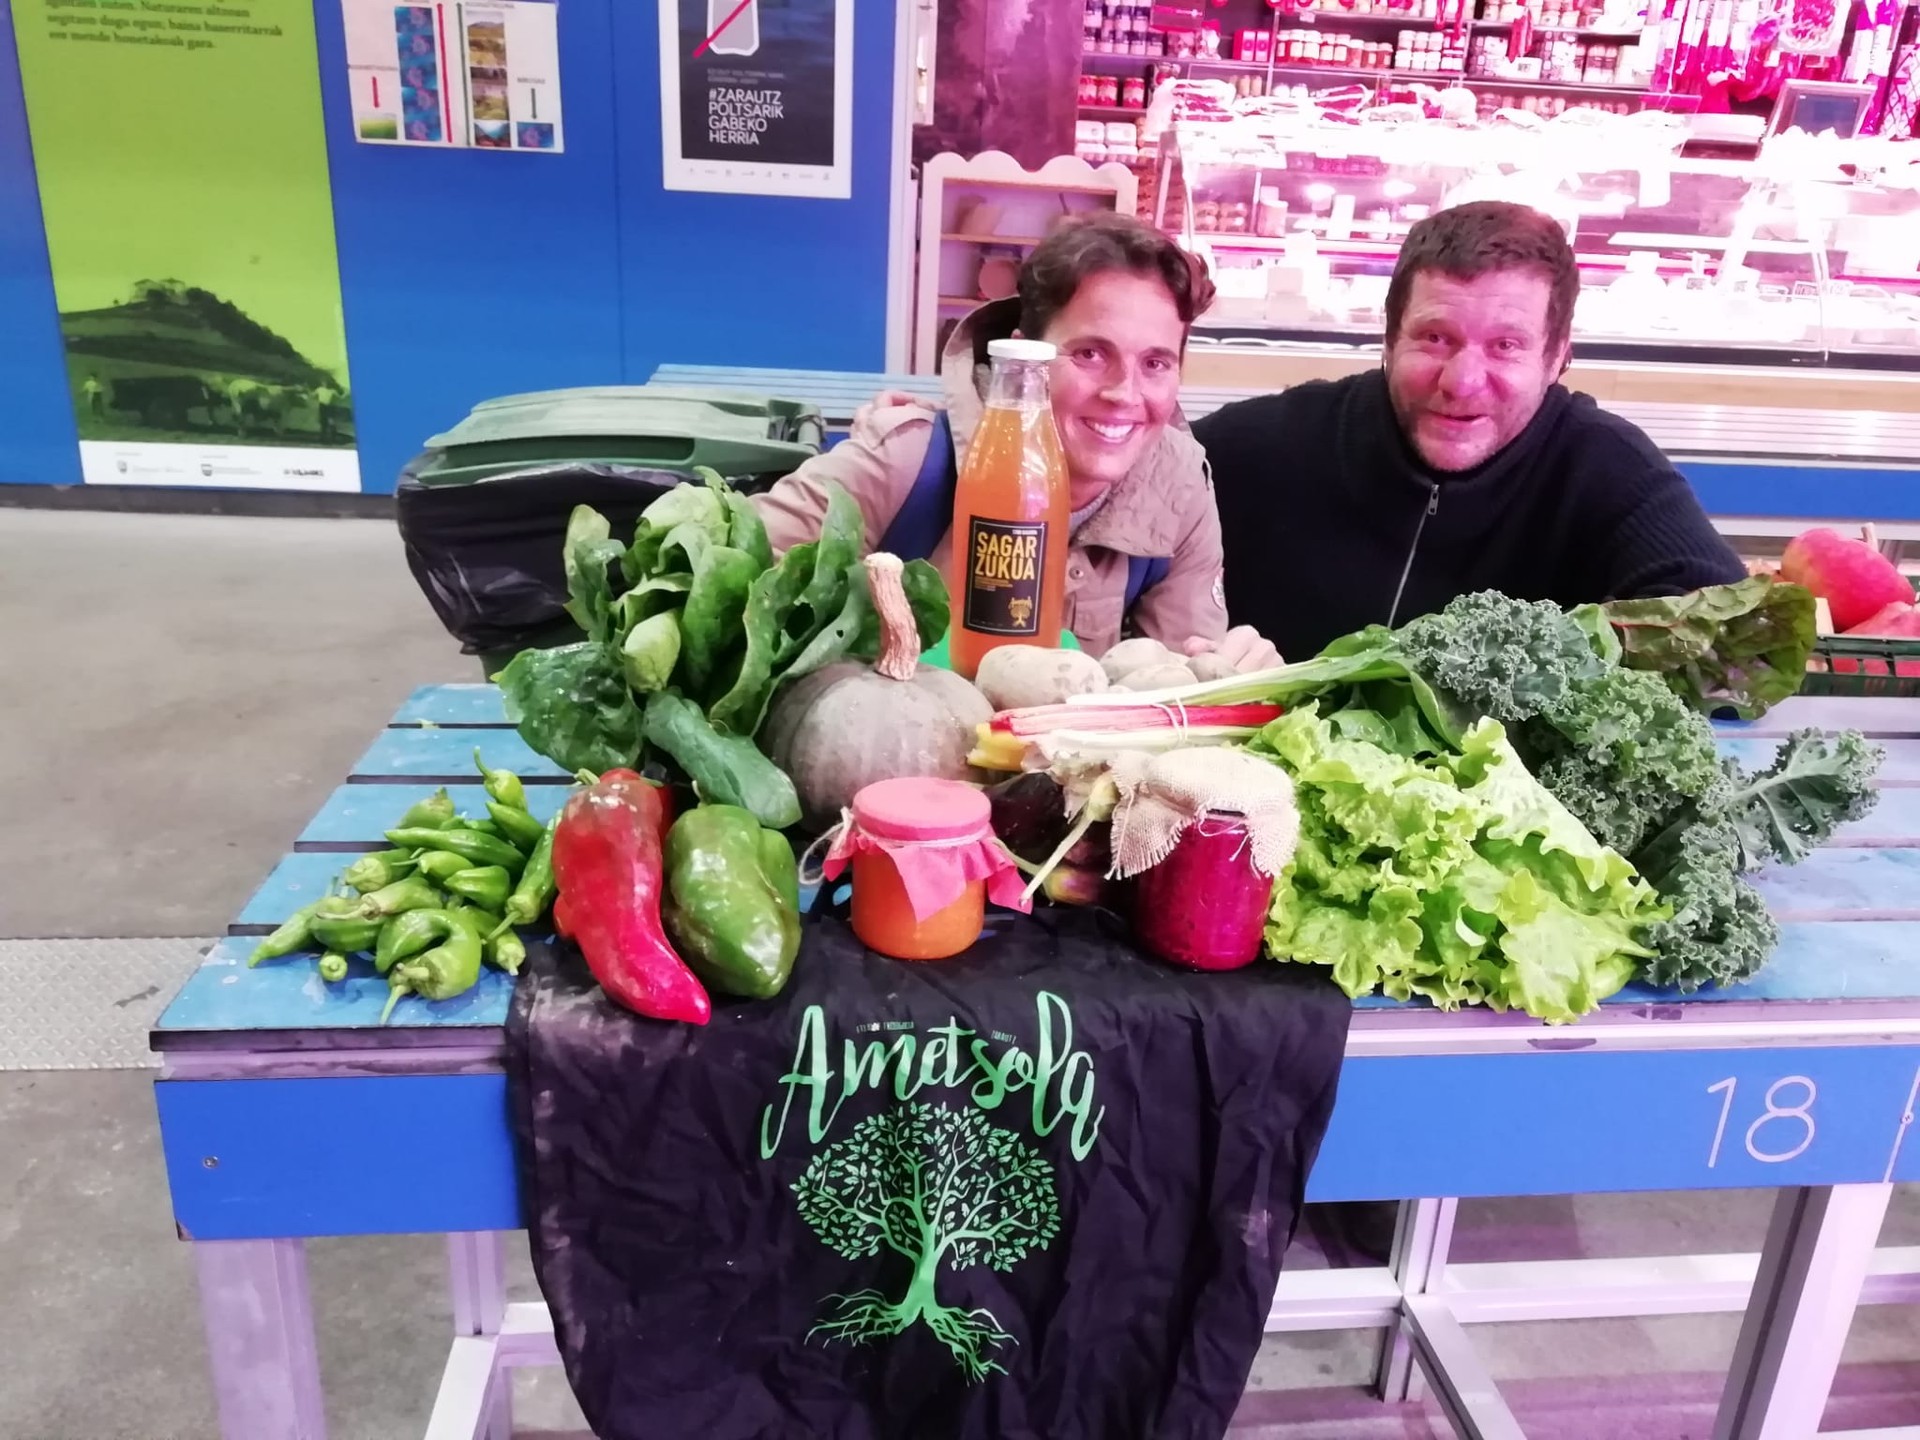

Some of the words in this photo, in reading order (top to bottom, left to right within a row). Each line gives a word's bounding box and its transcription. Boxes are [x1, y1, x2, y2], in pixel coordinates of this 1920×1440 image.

[708, 87, 782, 105] #ZARAUTZ
[708, 102, 784, 119] POLTSARIK
[708, 115, 768, 132] GABEKO
[708, 129, 760, 146] HERRIA
[976, 531, 1038, 559] SAGAR
[974, 553, 1036, 581] ZUKUA
[760, 990, 1106, 1161] Ametsola
[1707, 1075, 1817, 1169] 18
